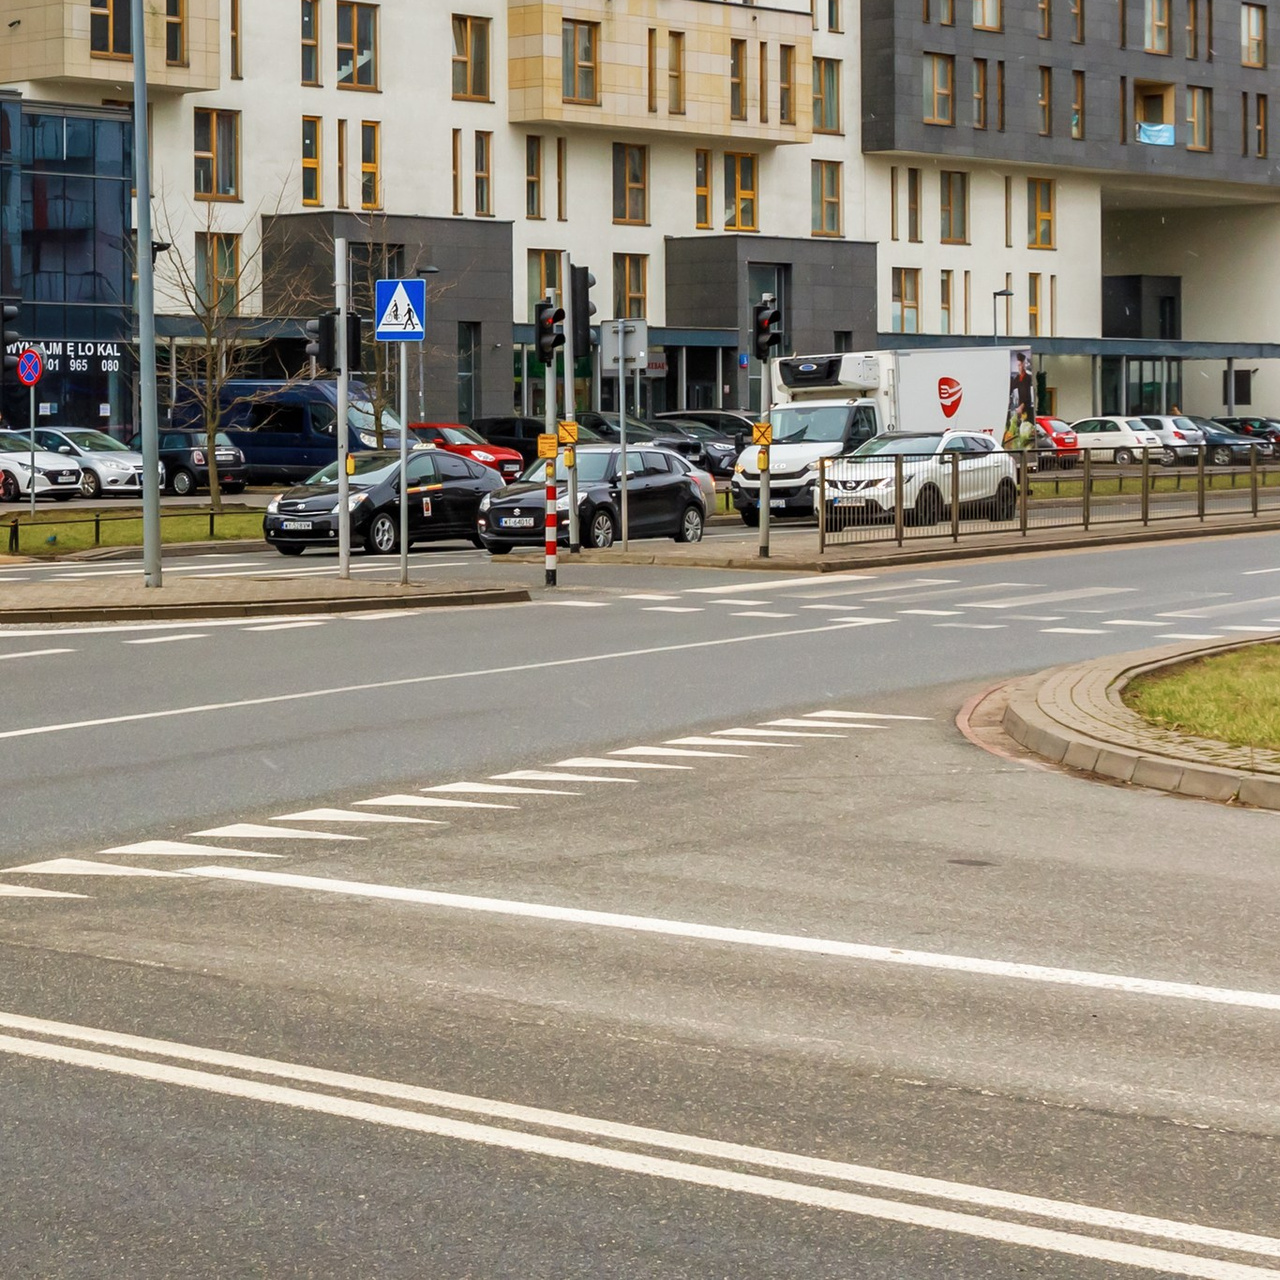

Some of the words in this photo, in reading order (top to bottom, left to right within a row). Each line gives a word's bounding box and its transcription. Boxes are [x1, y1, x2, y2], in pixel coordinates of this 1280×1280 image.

[46, 358, 60, 371] 01
[70, 359, 88, 371] 965
[101, 360, 119, 372] 080
